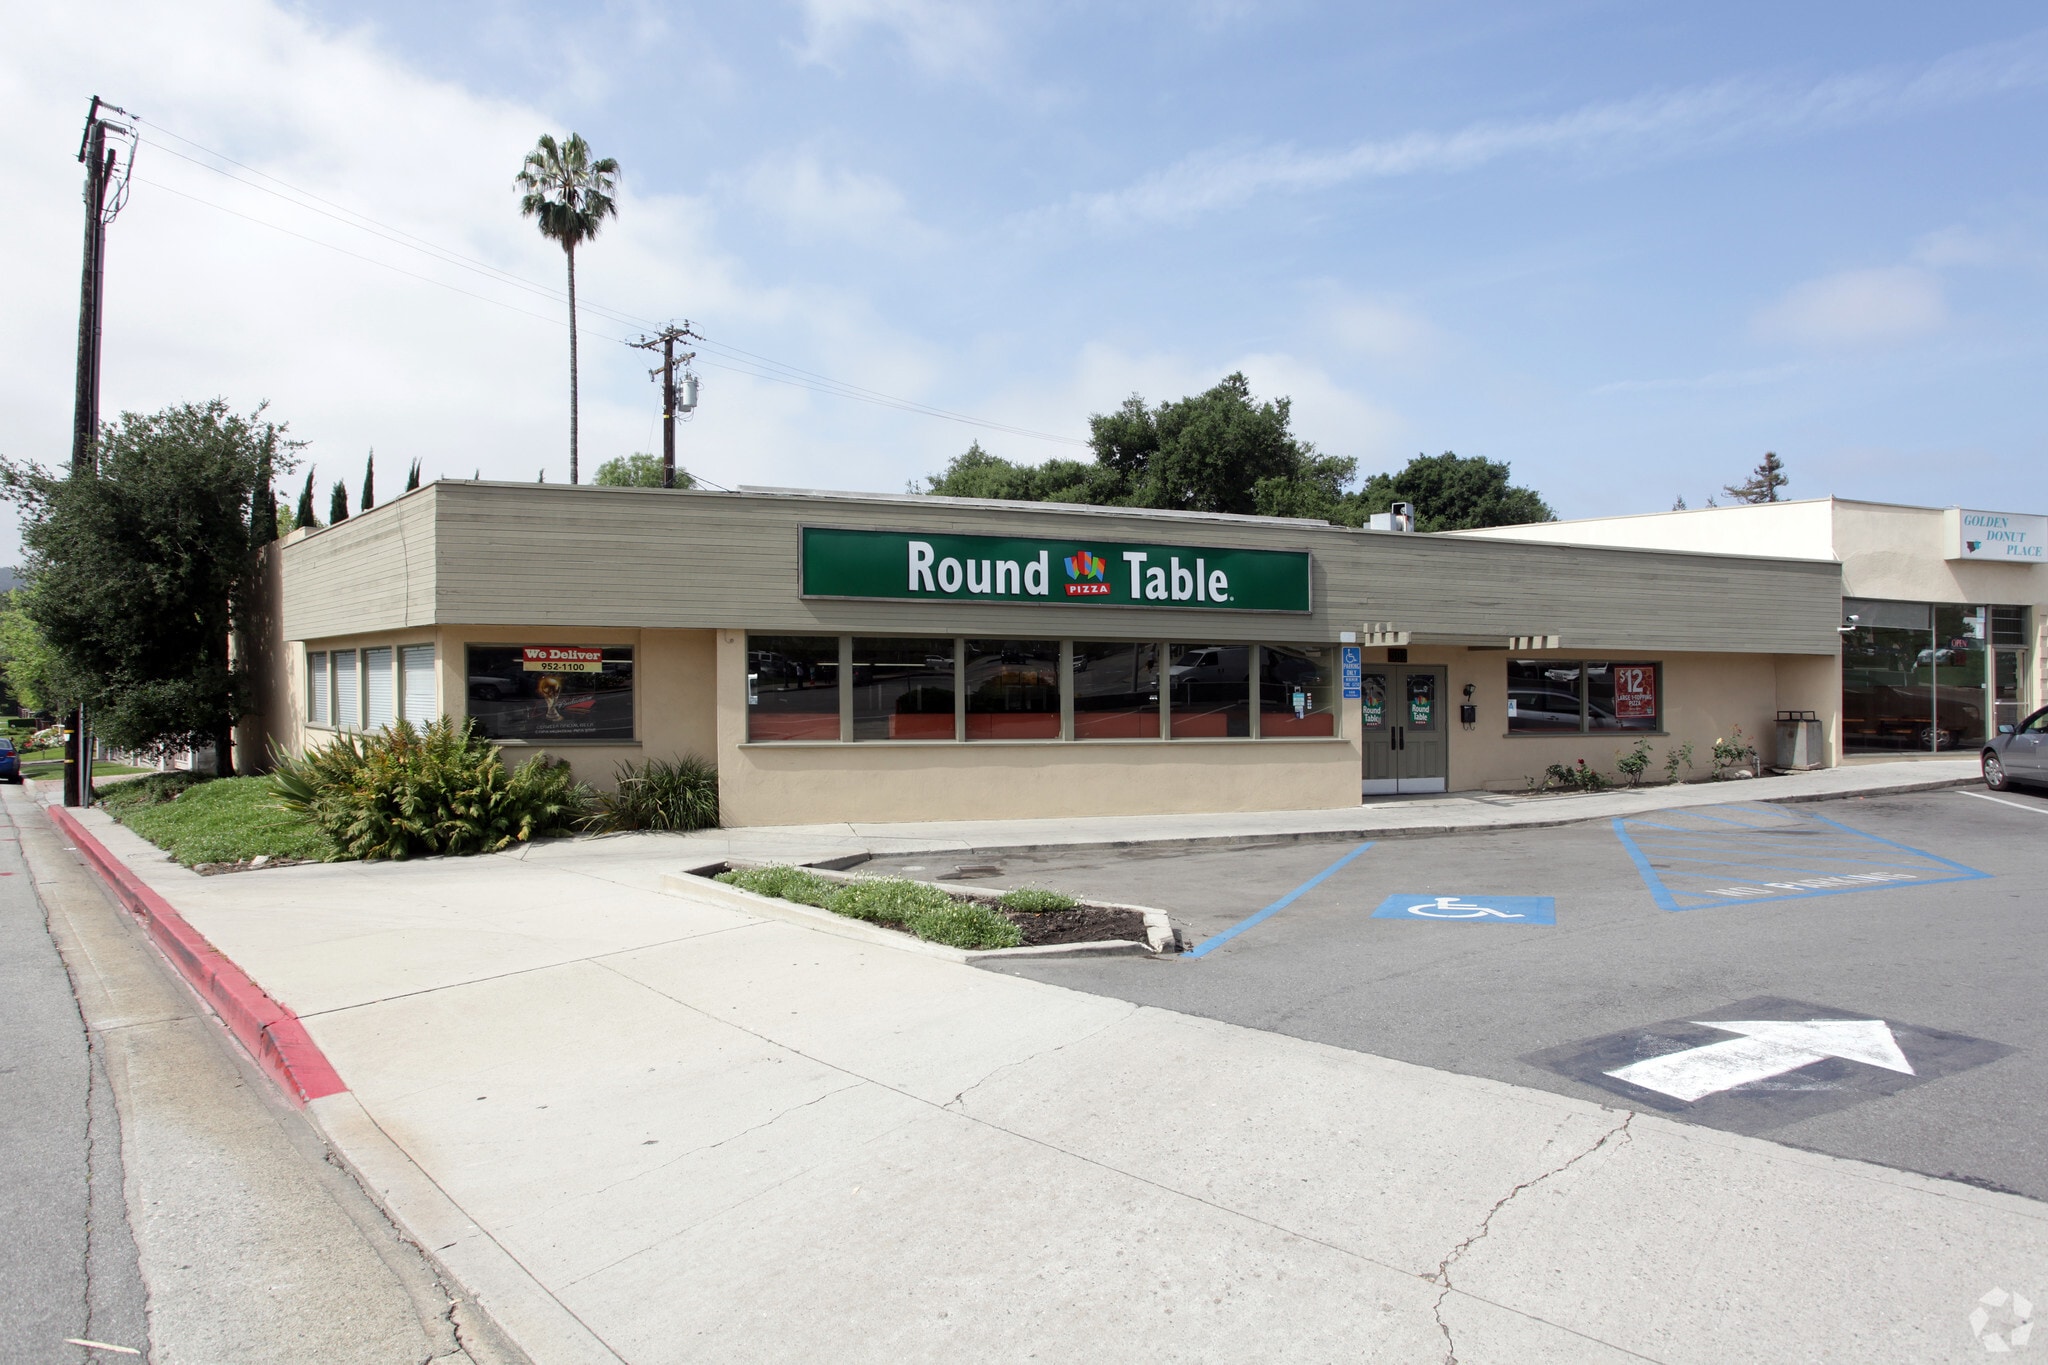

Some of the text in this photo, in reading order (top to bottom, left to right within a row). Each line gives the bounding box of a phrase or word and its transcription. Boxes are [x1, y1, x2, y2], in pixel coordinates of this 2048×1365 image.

[1964, 515, 2009, 528] GOLDEN
[1986, 530, 2026, 543] DONUT
[2006, 544, 2043, 557] PLACE
[908, 540, 1049, 596] Round
[1069, 585, 1108, 594] PIZZA
[1951, 639, 1968, 648] OPEN
[525, 649, 600, 660] We Deliver
[541, 662, 585, 671] 952-1100
[1620, 669, 1643, 692] $12
[1363, 705, 1381, 714] Round
[1412, 704, 1430, 713] Round
[1413, 712, 1428, 721] Table
[1705, 872, 1918, 897] NO PARKING
